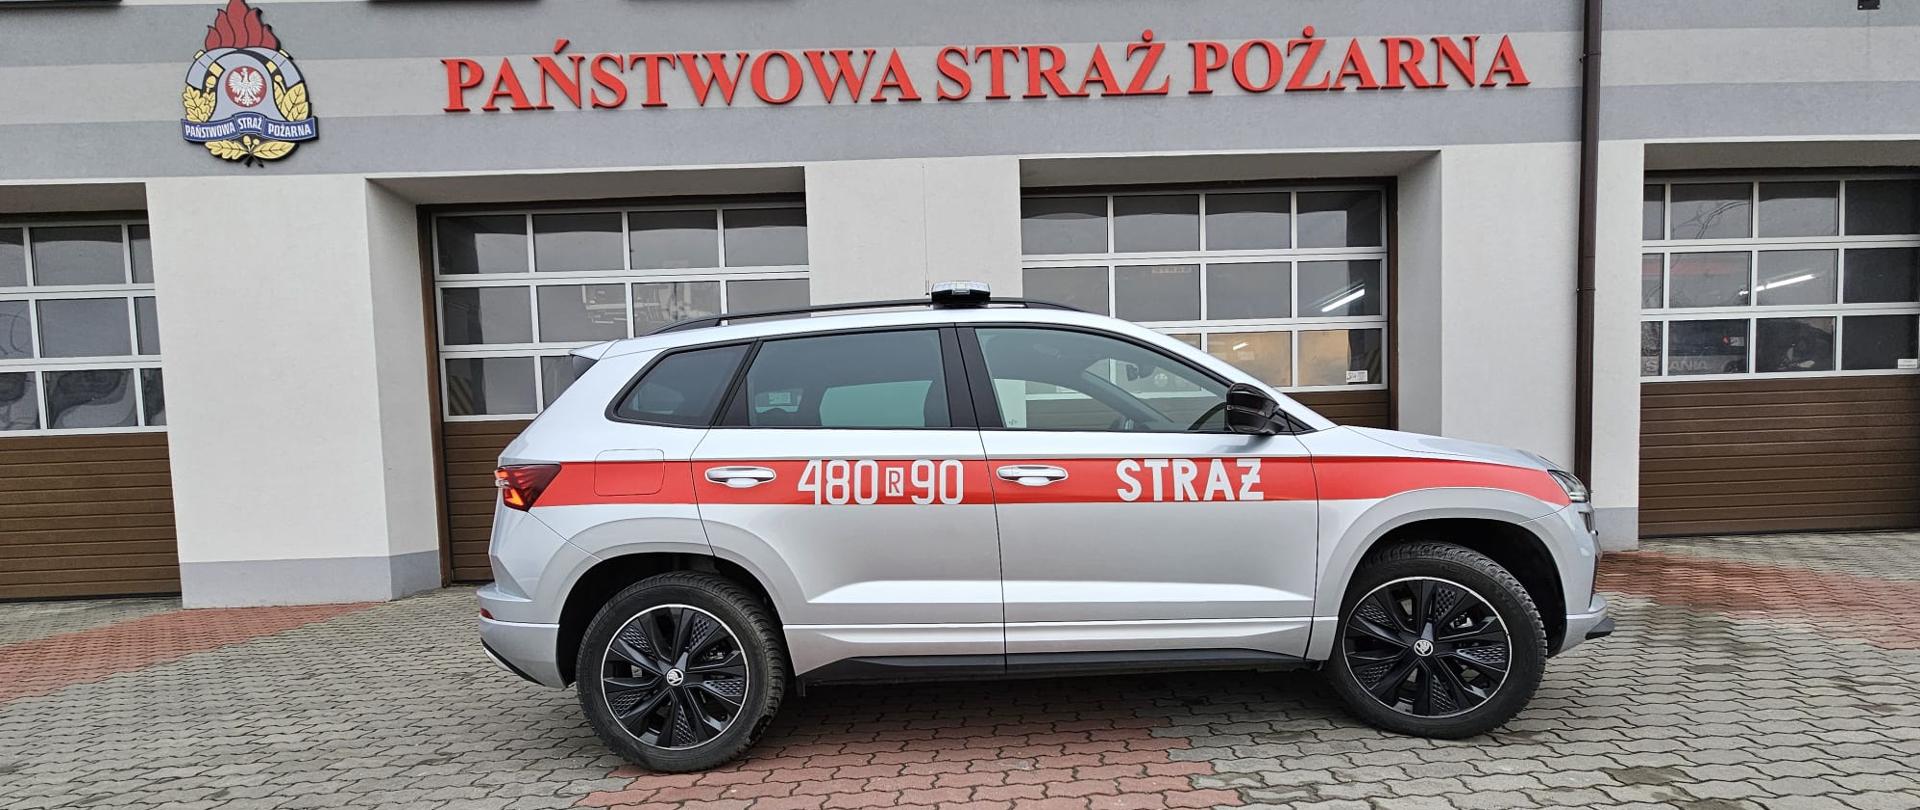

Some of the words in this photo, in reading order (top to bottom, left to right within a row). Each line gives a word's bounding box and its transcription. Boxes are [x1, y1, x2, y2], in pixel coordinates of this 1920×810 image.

[441, 38, 921, 112] PAŃSTWOWA
[936, 29, 1171, 102] STRAŻ
[1188, 24, 1532, 94] POŻARNA
[185, 122, 236, 138] PAŃSTWOWA
[237, 117, 263, 130] STRAŻ
[267, 122, 312, 138] POŻARNA
[1646, 359, 1708, 372] SANIA
